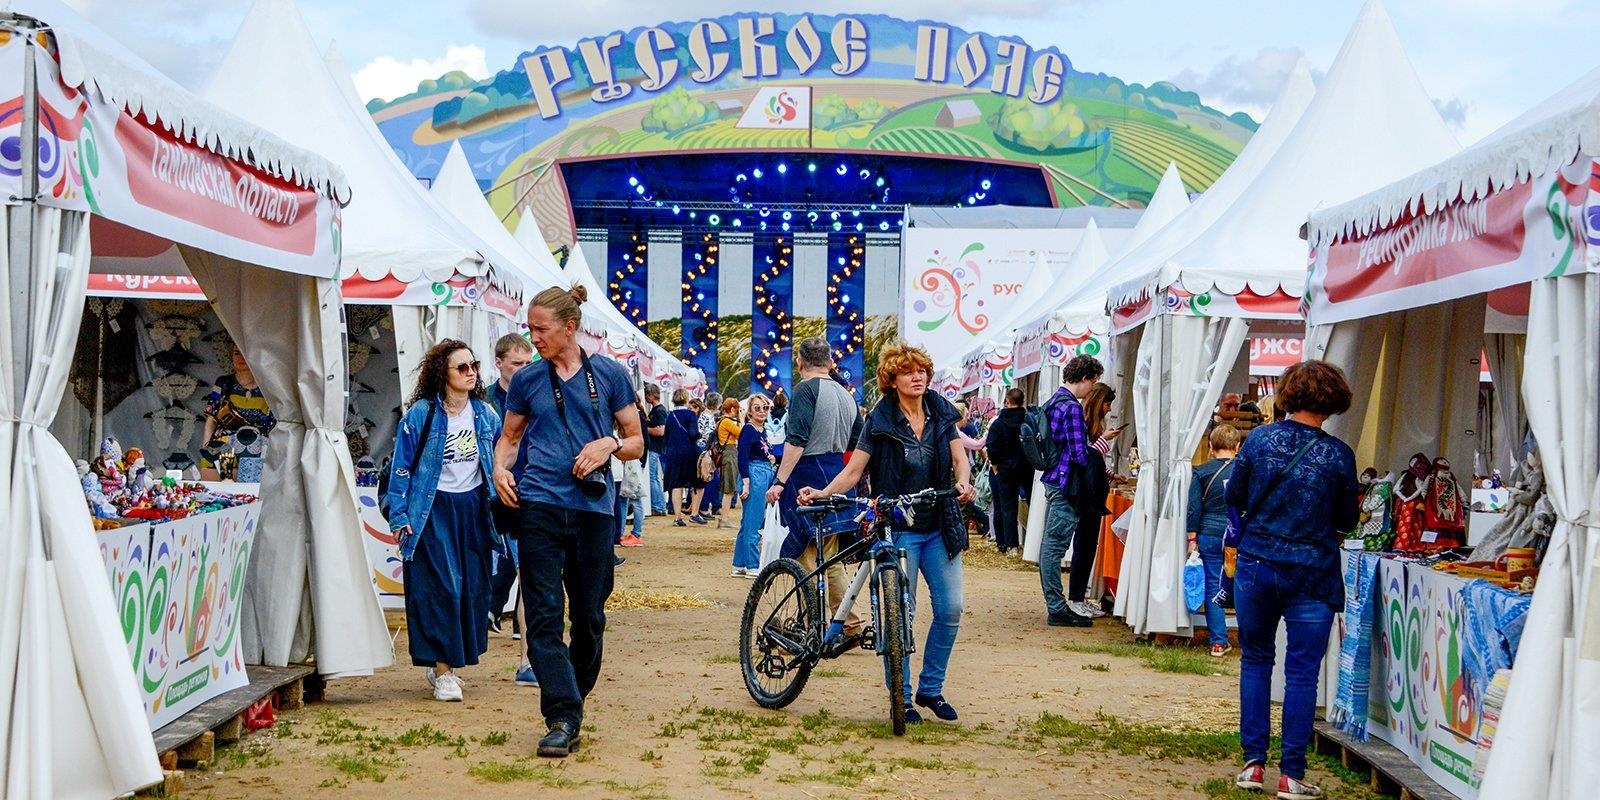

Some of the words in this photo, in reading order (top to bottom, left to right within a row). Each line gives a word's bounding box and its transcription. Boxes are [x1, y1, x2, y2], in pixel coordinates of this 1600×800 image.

[523, 16, 867, 119] РУССКОЕ
[914, 25, 1064, 104] ПОЛЕ
[235, 174, 299, 225] область
[1250, 337, 1306, 360] ужс
[586, 372, 596, 393] SONY
